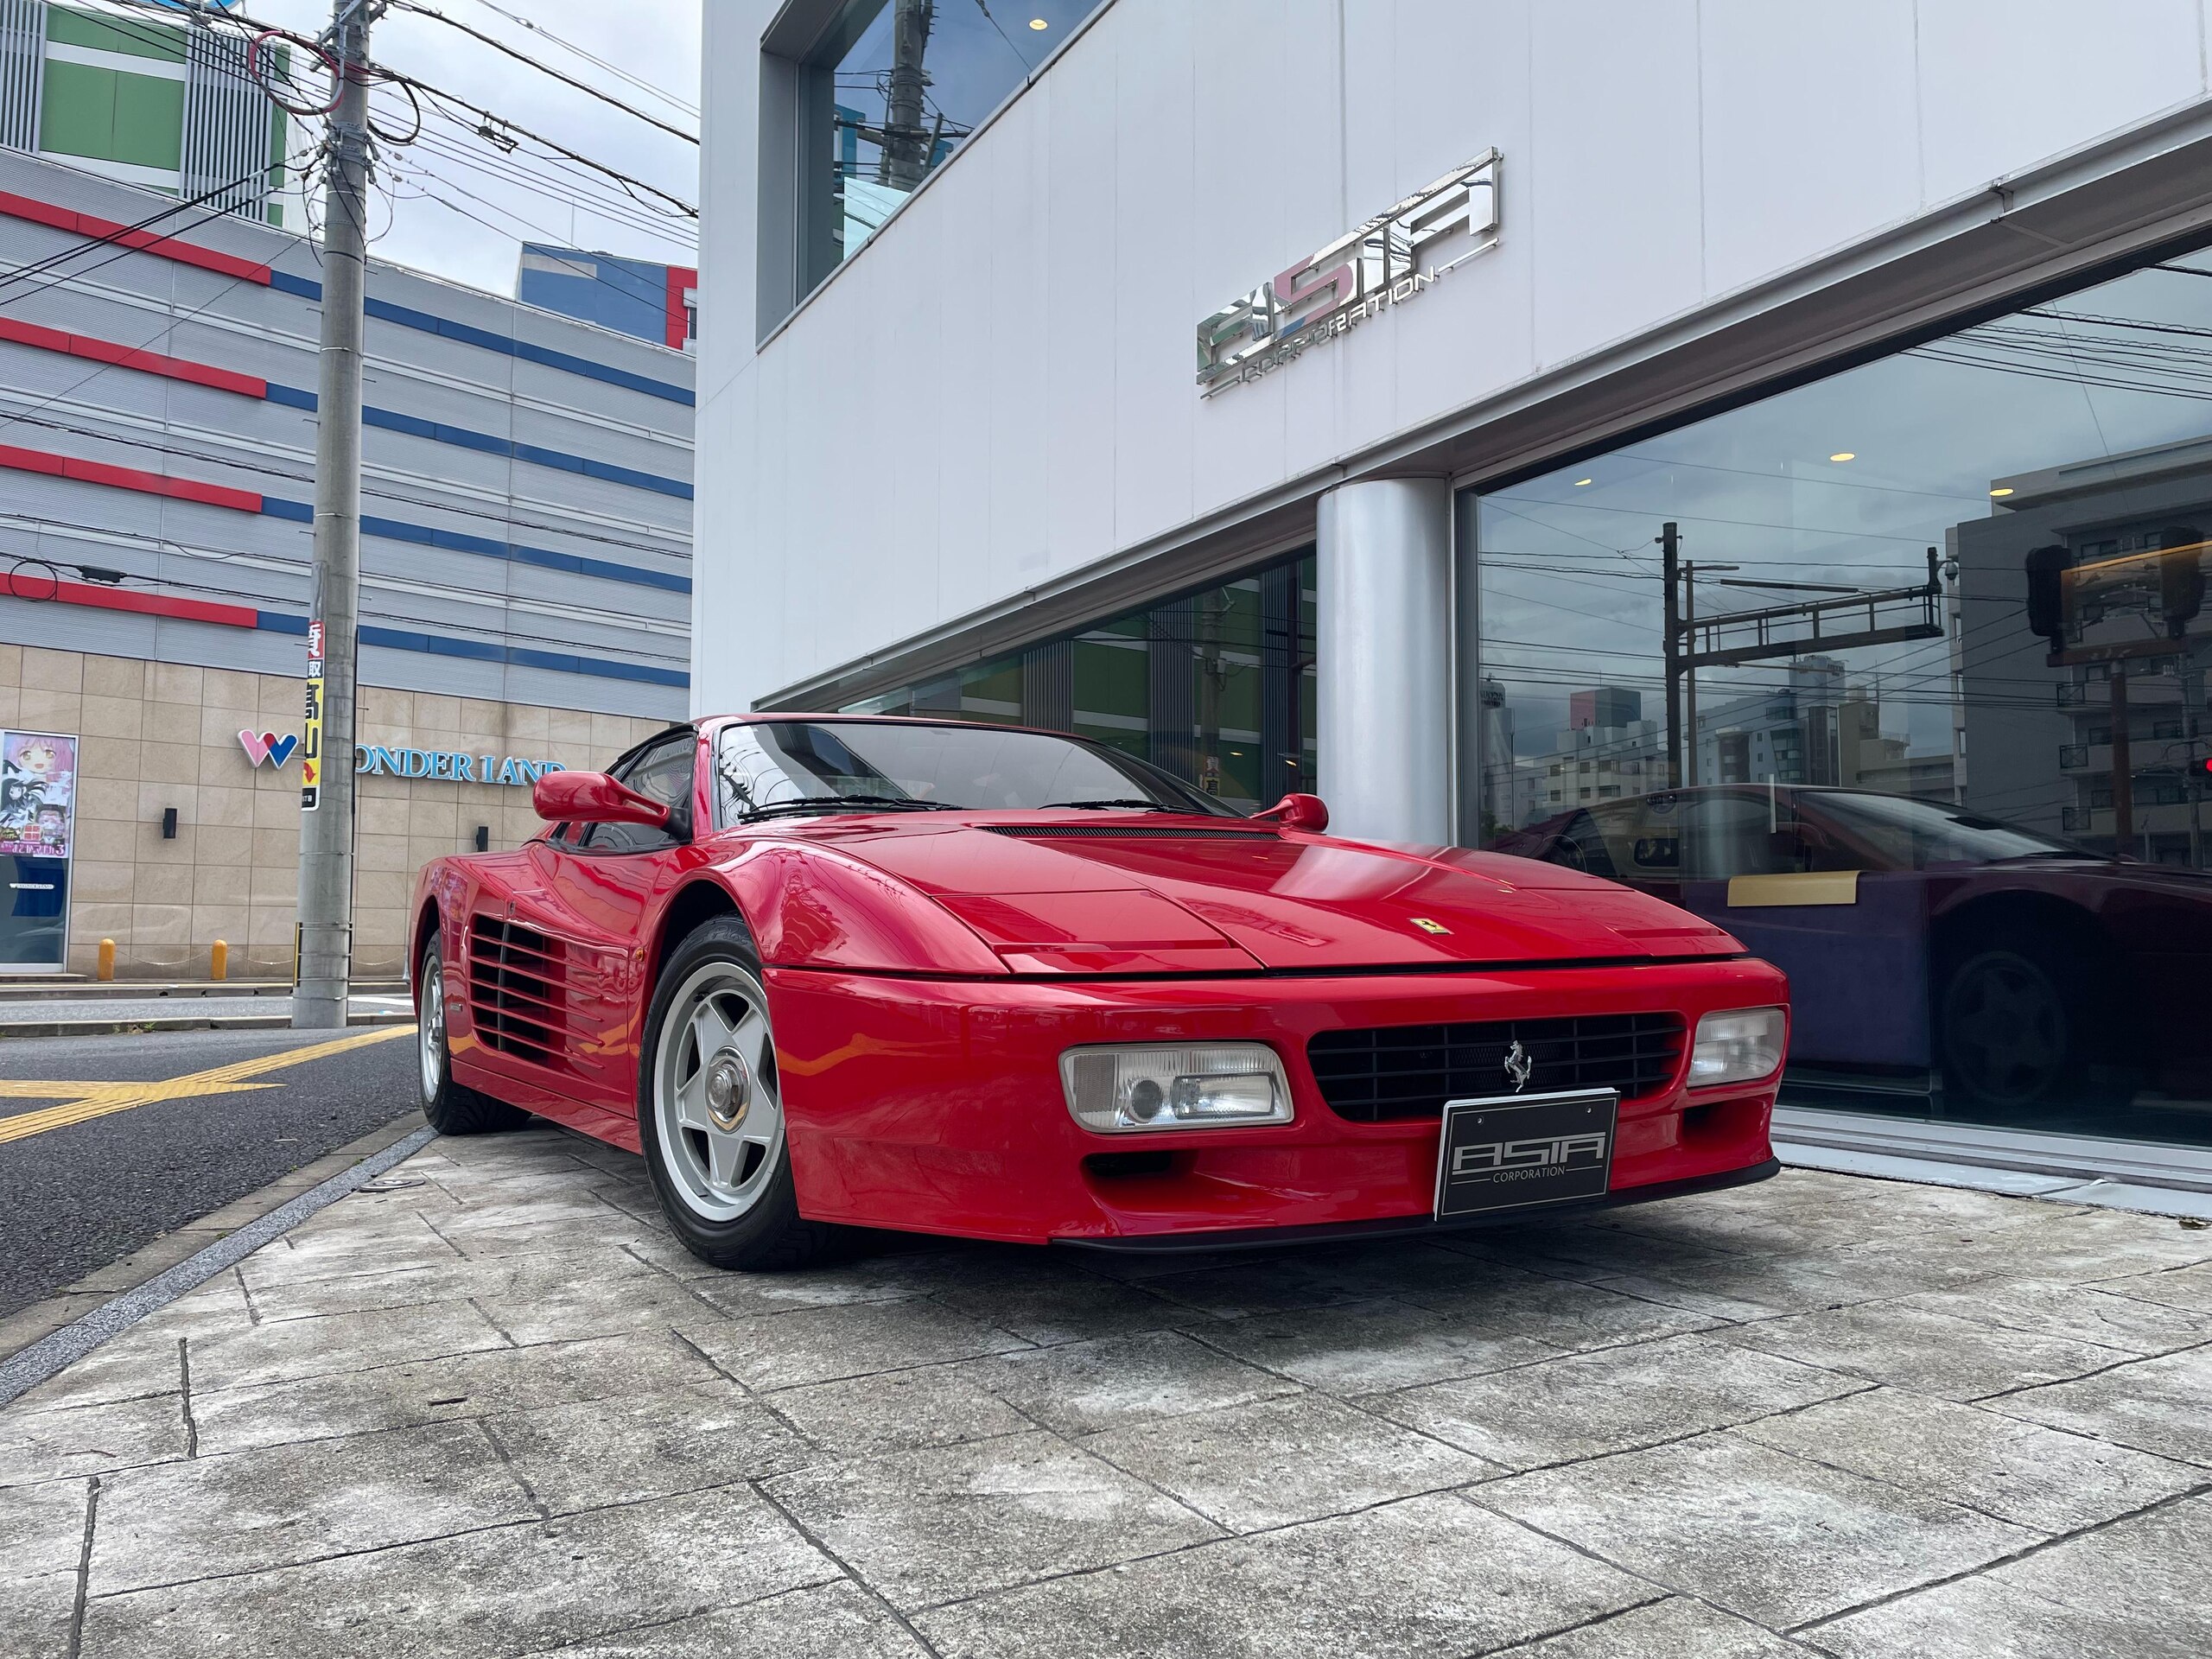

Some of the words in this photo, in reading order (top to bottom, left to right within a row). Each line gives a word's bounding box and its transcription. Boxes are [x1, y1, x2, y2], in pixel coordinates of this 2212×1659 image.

[1197, 146, 1498, 385] ASIA
[1241, 265, 1435, 384] CORPORATION
[355, 744, 476, 782] ONDER
[1452, 1132, 1606, 1175] ASIA
[1492, 1166, 1566, 1184] CORPORATION
